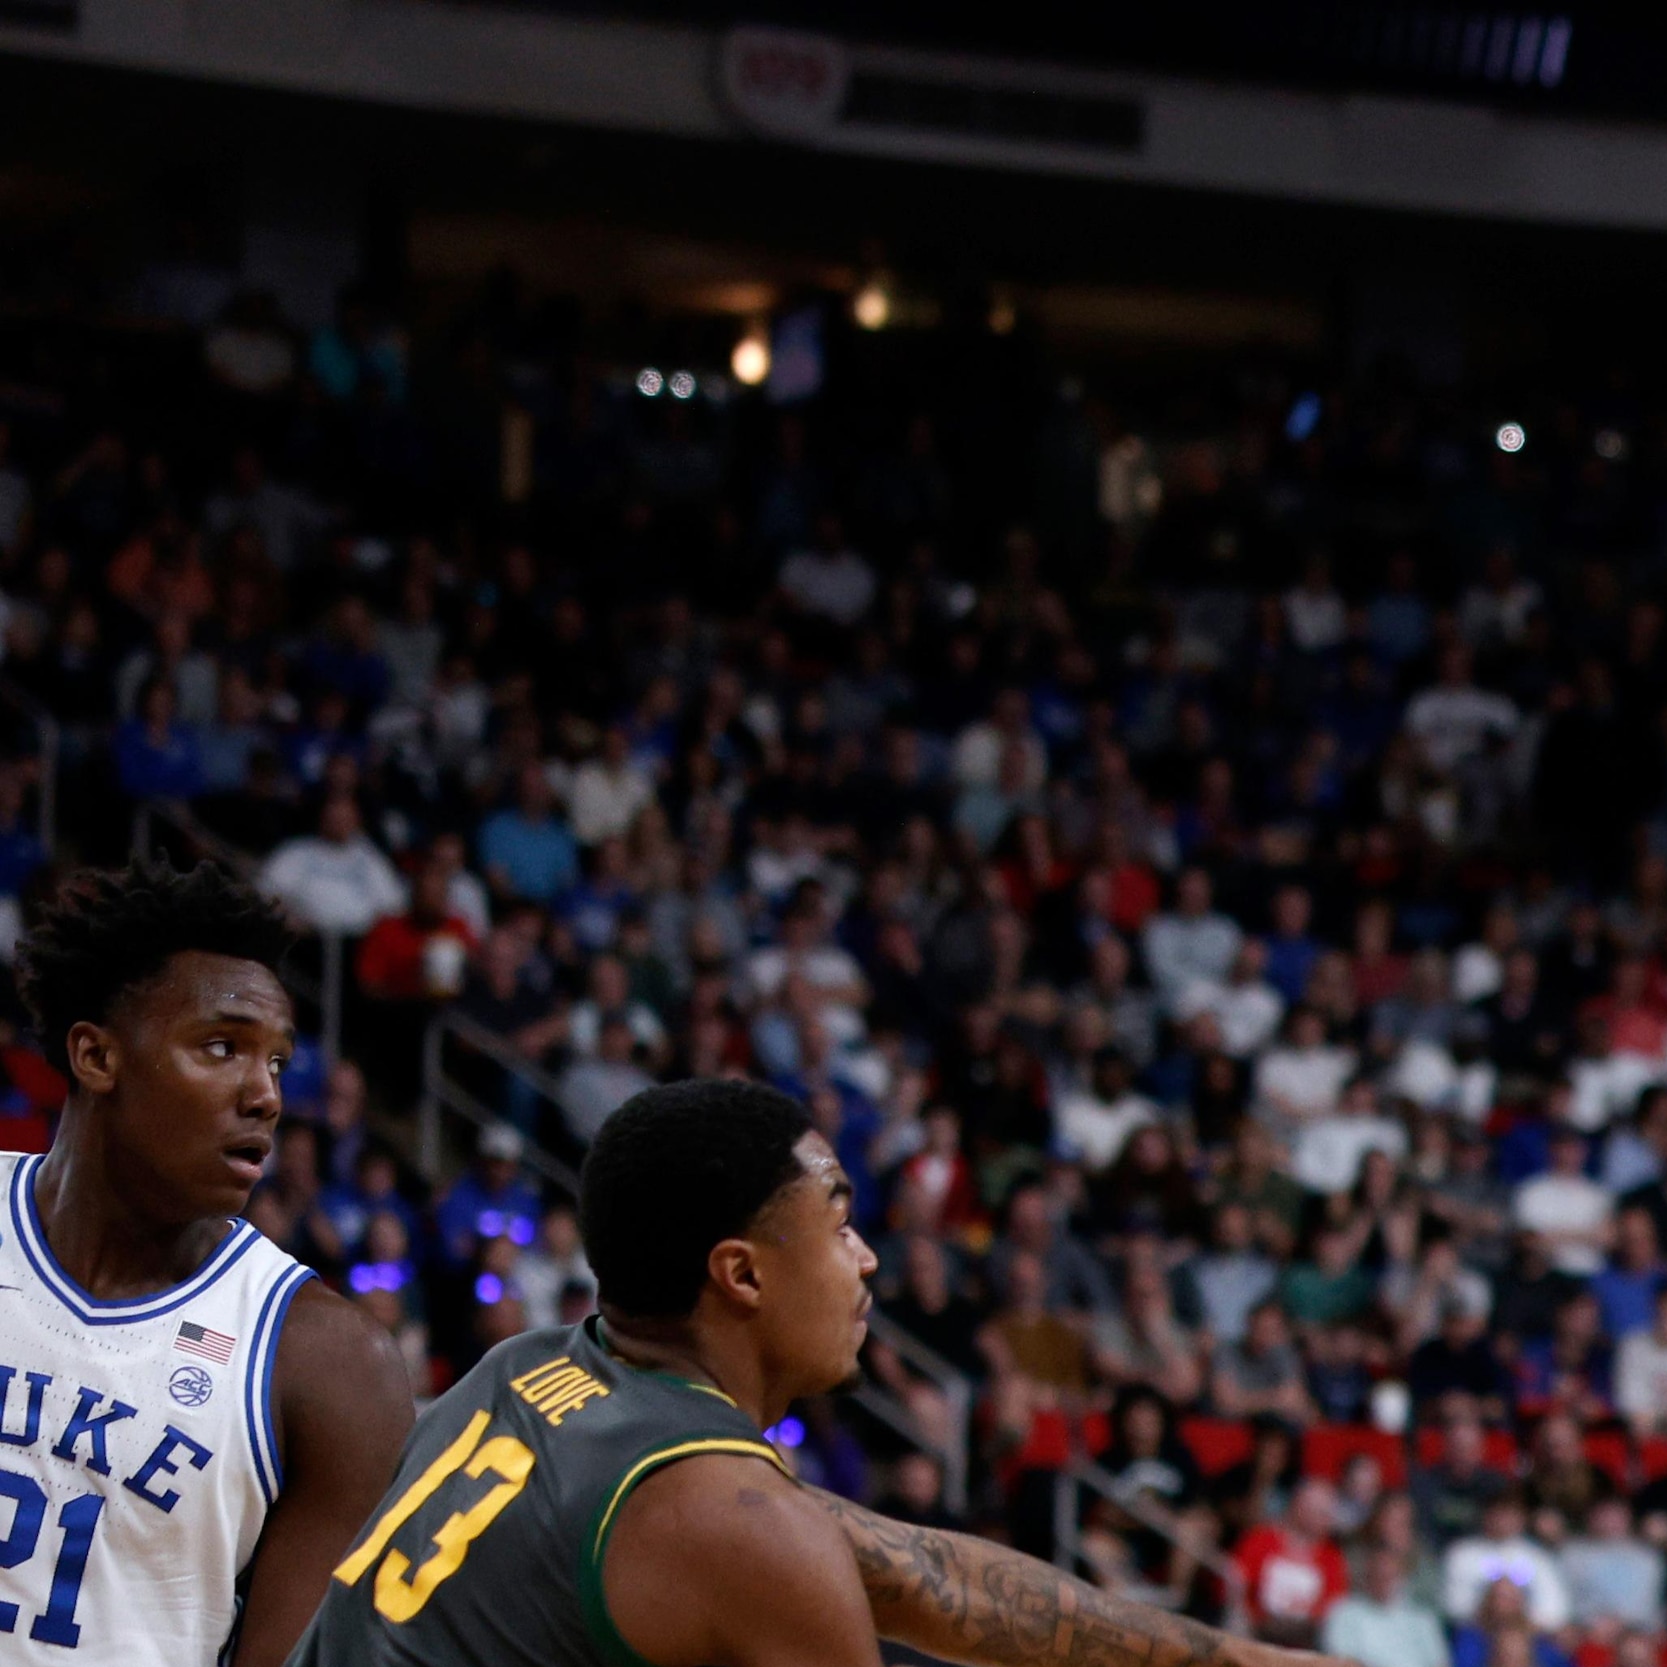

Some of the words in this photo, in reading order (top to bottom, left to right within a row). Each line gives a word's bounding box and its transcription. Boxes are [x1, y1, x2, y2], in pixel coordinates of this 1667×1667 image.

[0, 1365, 213, 1513] UKE
[509, 1356, 610, 1427] LOVE
[333, 1409, 536, 1624] 13
